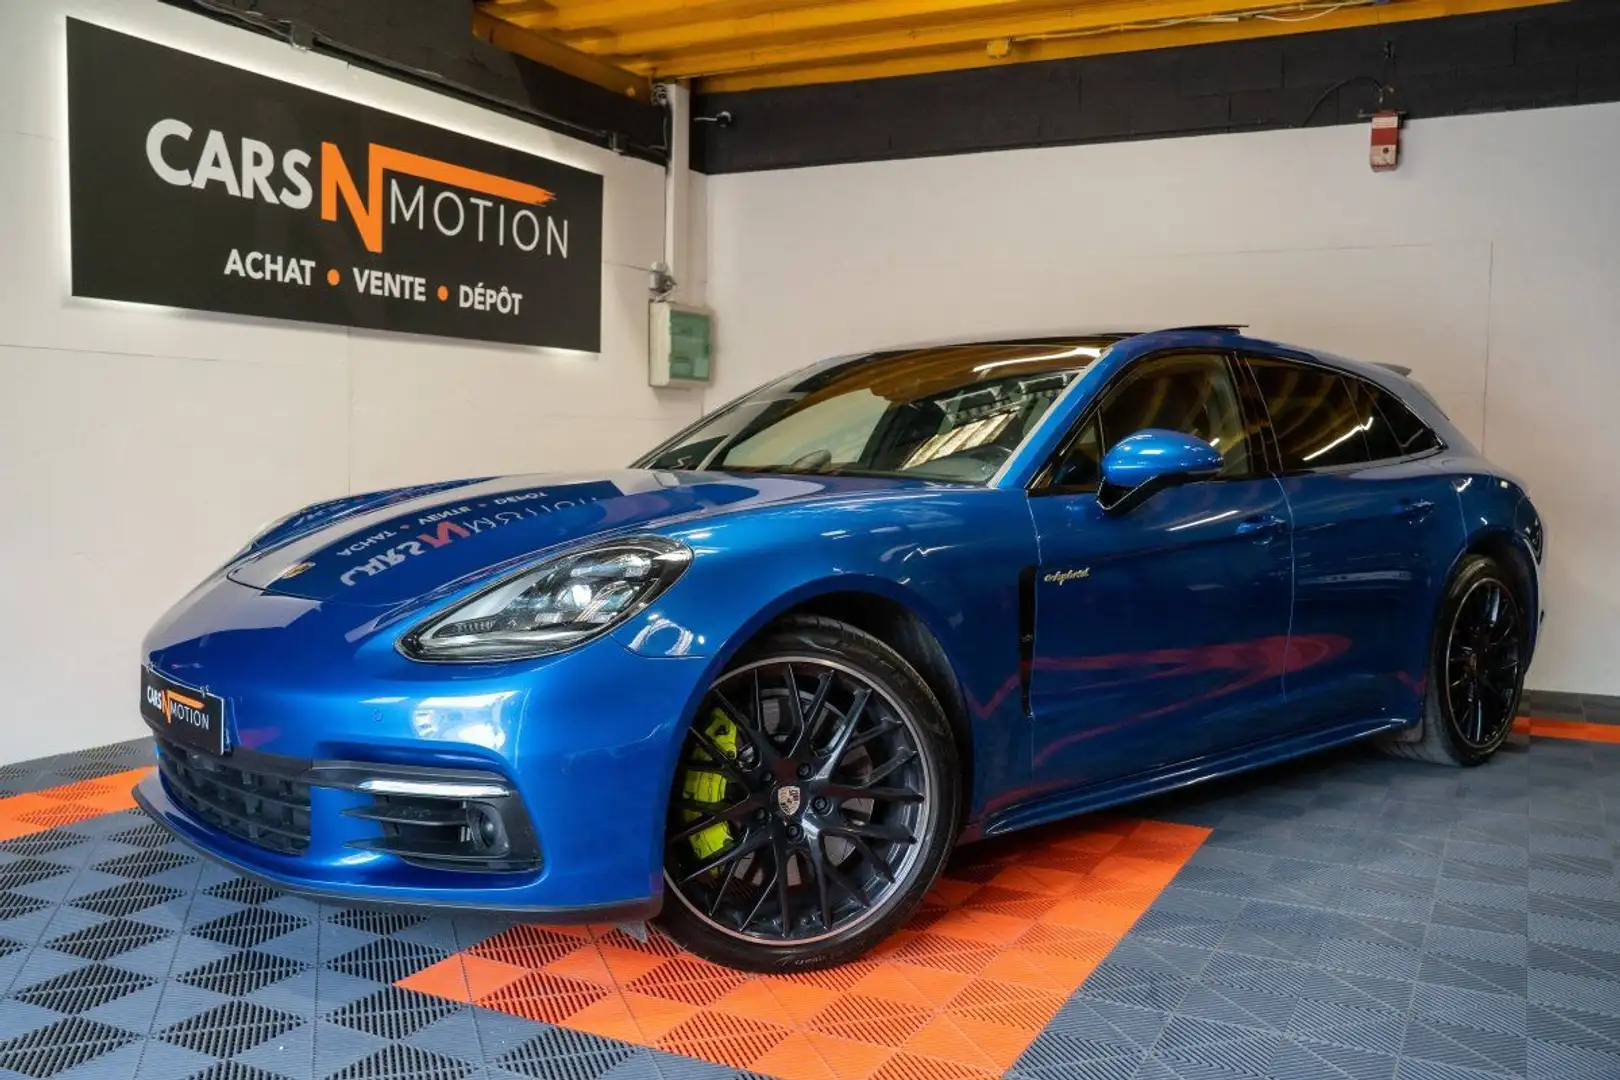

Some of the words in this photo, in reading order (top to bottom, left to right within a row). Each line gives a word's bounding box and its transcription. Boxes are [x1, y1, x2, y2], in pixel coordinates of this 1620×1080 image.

[146, 118, 313, 210] CARS
[390, 178, 568, 259] MOTION
[223, 248, 316, 286] ACHAT
[352, 267, 426, 302] VENTE
[459, 282, 524, 316] DÉPÔT
[170, 700, 210, 730] MOTION
